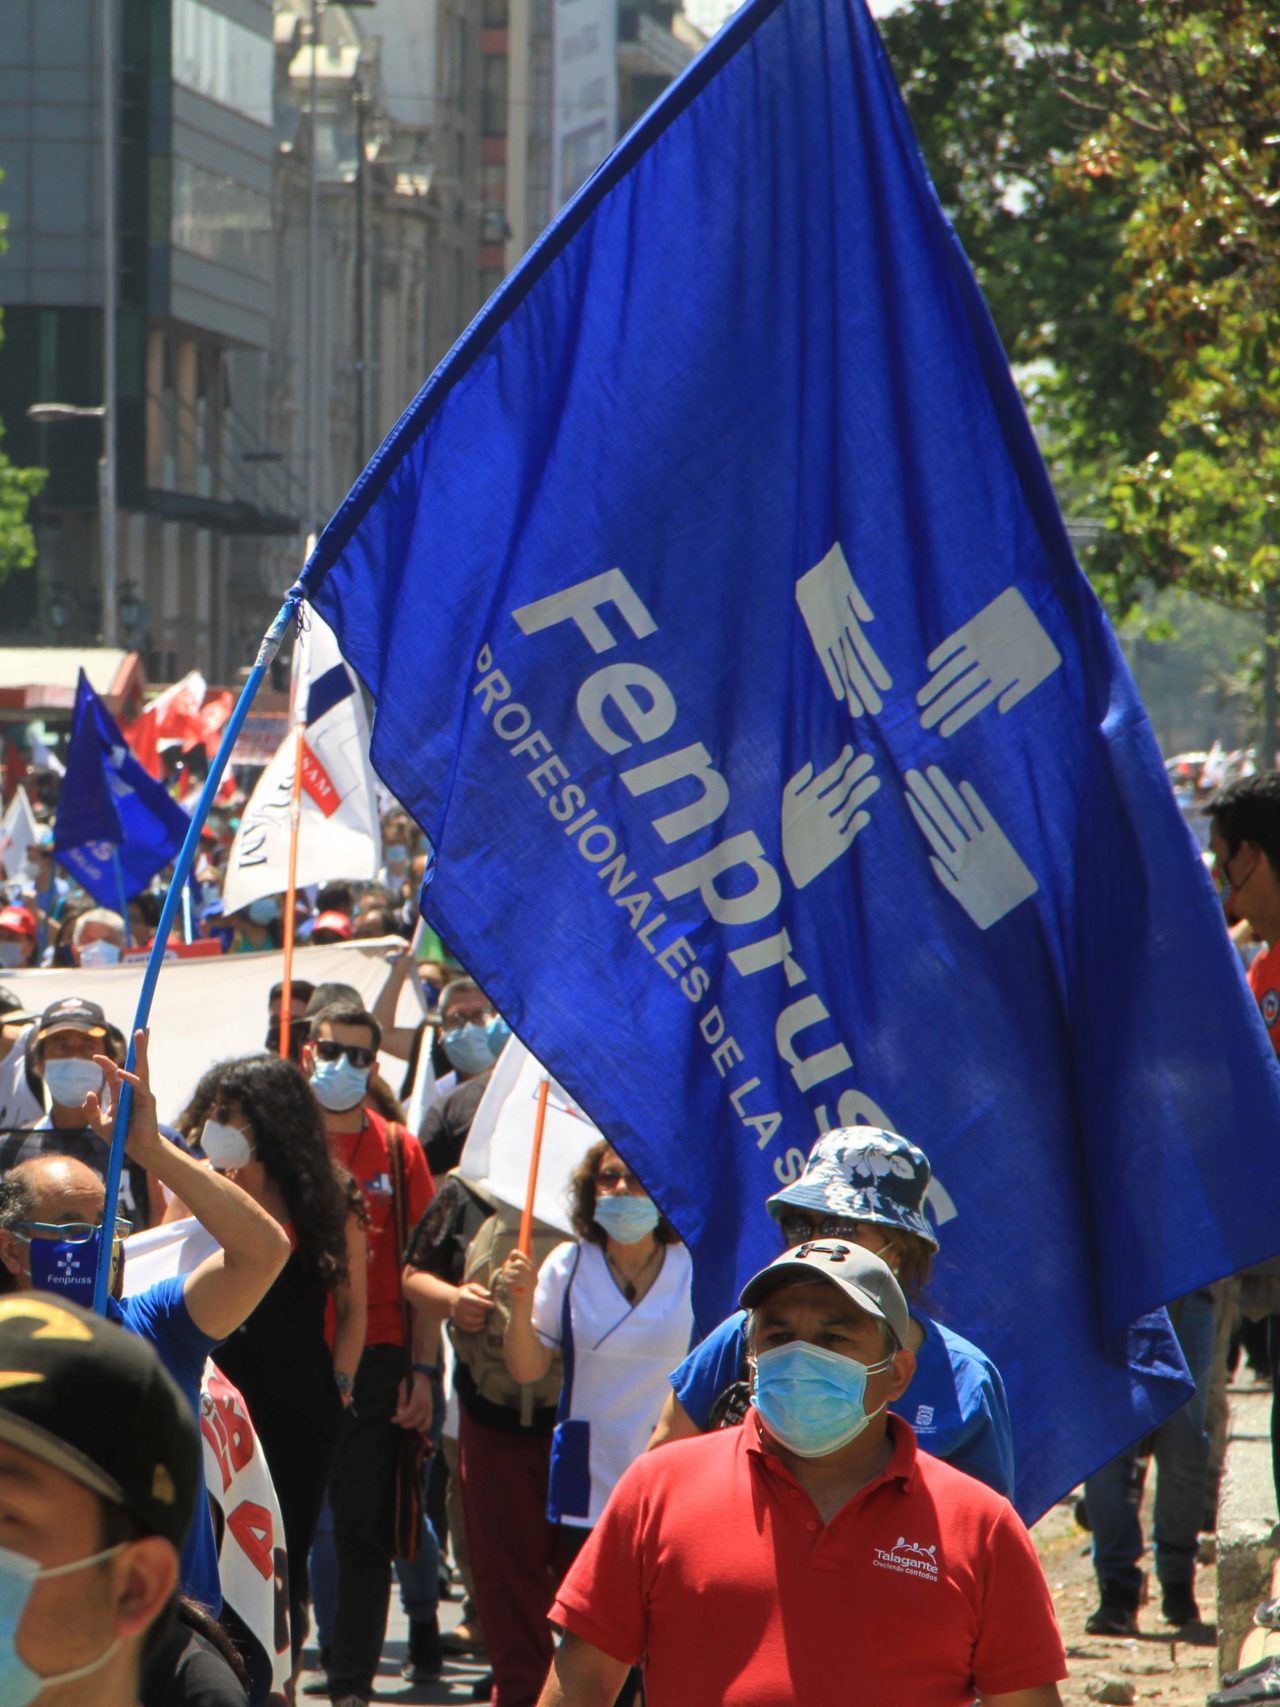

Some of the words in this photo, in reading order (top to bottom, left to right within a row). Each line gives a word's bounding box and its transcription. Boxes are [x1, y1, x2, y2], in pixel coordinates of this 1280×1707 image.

[472, 643, 710, 1003] PROFESIONALES
[699, 1003, 745, 1078] DE
[729, 1077, 782, 1151] LA
[512, 567, 956, 1227] Fenprus
[47, 1274, 93, 1286] Fenpruss
[874, 1547, 938, 1574] Talagante
